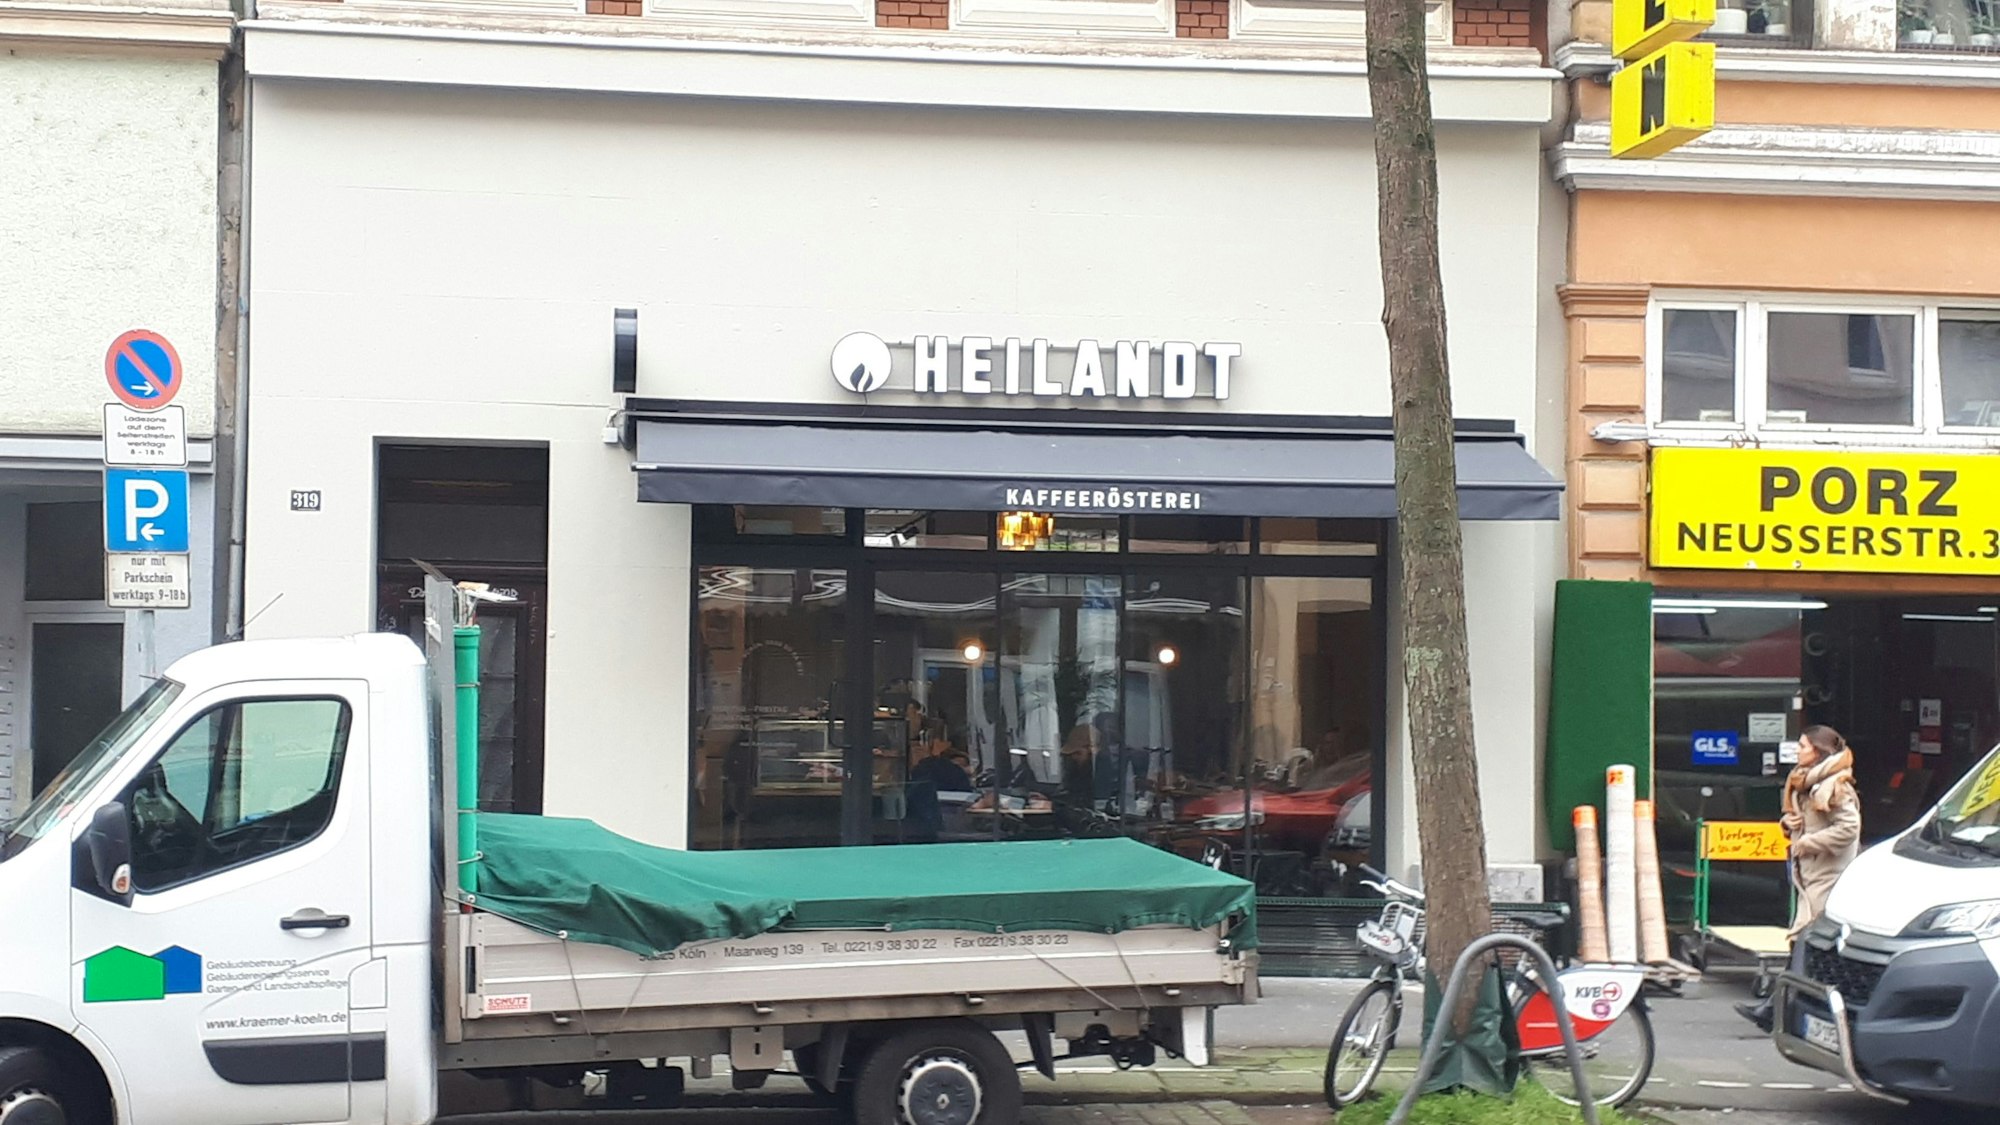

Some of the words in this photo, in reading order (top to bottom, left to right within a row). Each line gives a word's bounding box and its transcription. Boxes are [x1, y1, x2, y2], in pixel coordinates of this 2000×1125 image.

[914, 334, 1242, 400] HEILANDT
[124, 415, 167, 423] Ladezone
[127, 441, 166, 449] werktags
[1006, 487, 1201, 510] KAFFEERÖSTEREI
[1760, 466, 1958, 517] PORZ
[293, 492, 319, 508] 319
[124, 479, 169, 541] P
[131, 556, 146, 566] nur
[150, 556, 166, 566] mit
[124, 571, 174, 583] Parkschein
[112, 589, 155, 603] werktags
[1694, 737, 1729, 753] GLS
[723, 945, 782, 960] Maarweg
[783, 943, 804, 955] 139
[821, 942, 841, 954] Tel.
[887, 939, 902, 951] 38
[905, 938, 920, 950] 30
[922, 937, 938, 949] 22
[953, 936, 975, 948] Fax
[1020, 934, 1035, 946] 38
[1036, 934, 1052, 945] 30
[1054, 933, 1069, 945] 23
[1575, 986, 1601, 999] KVB
[206, 1012, 347, 1029] www.kraemer-koeln.de
